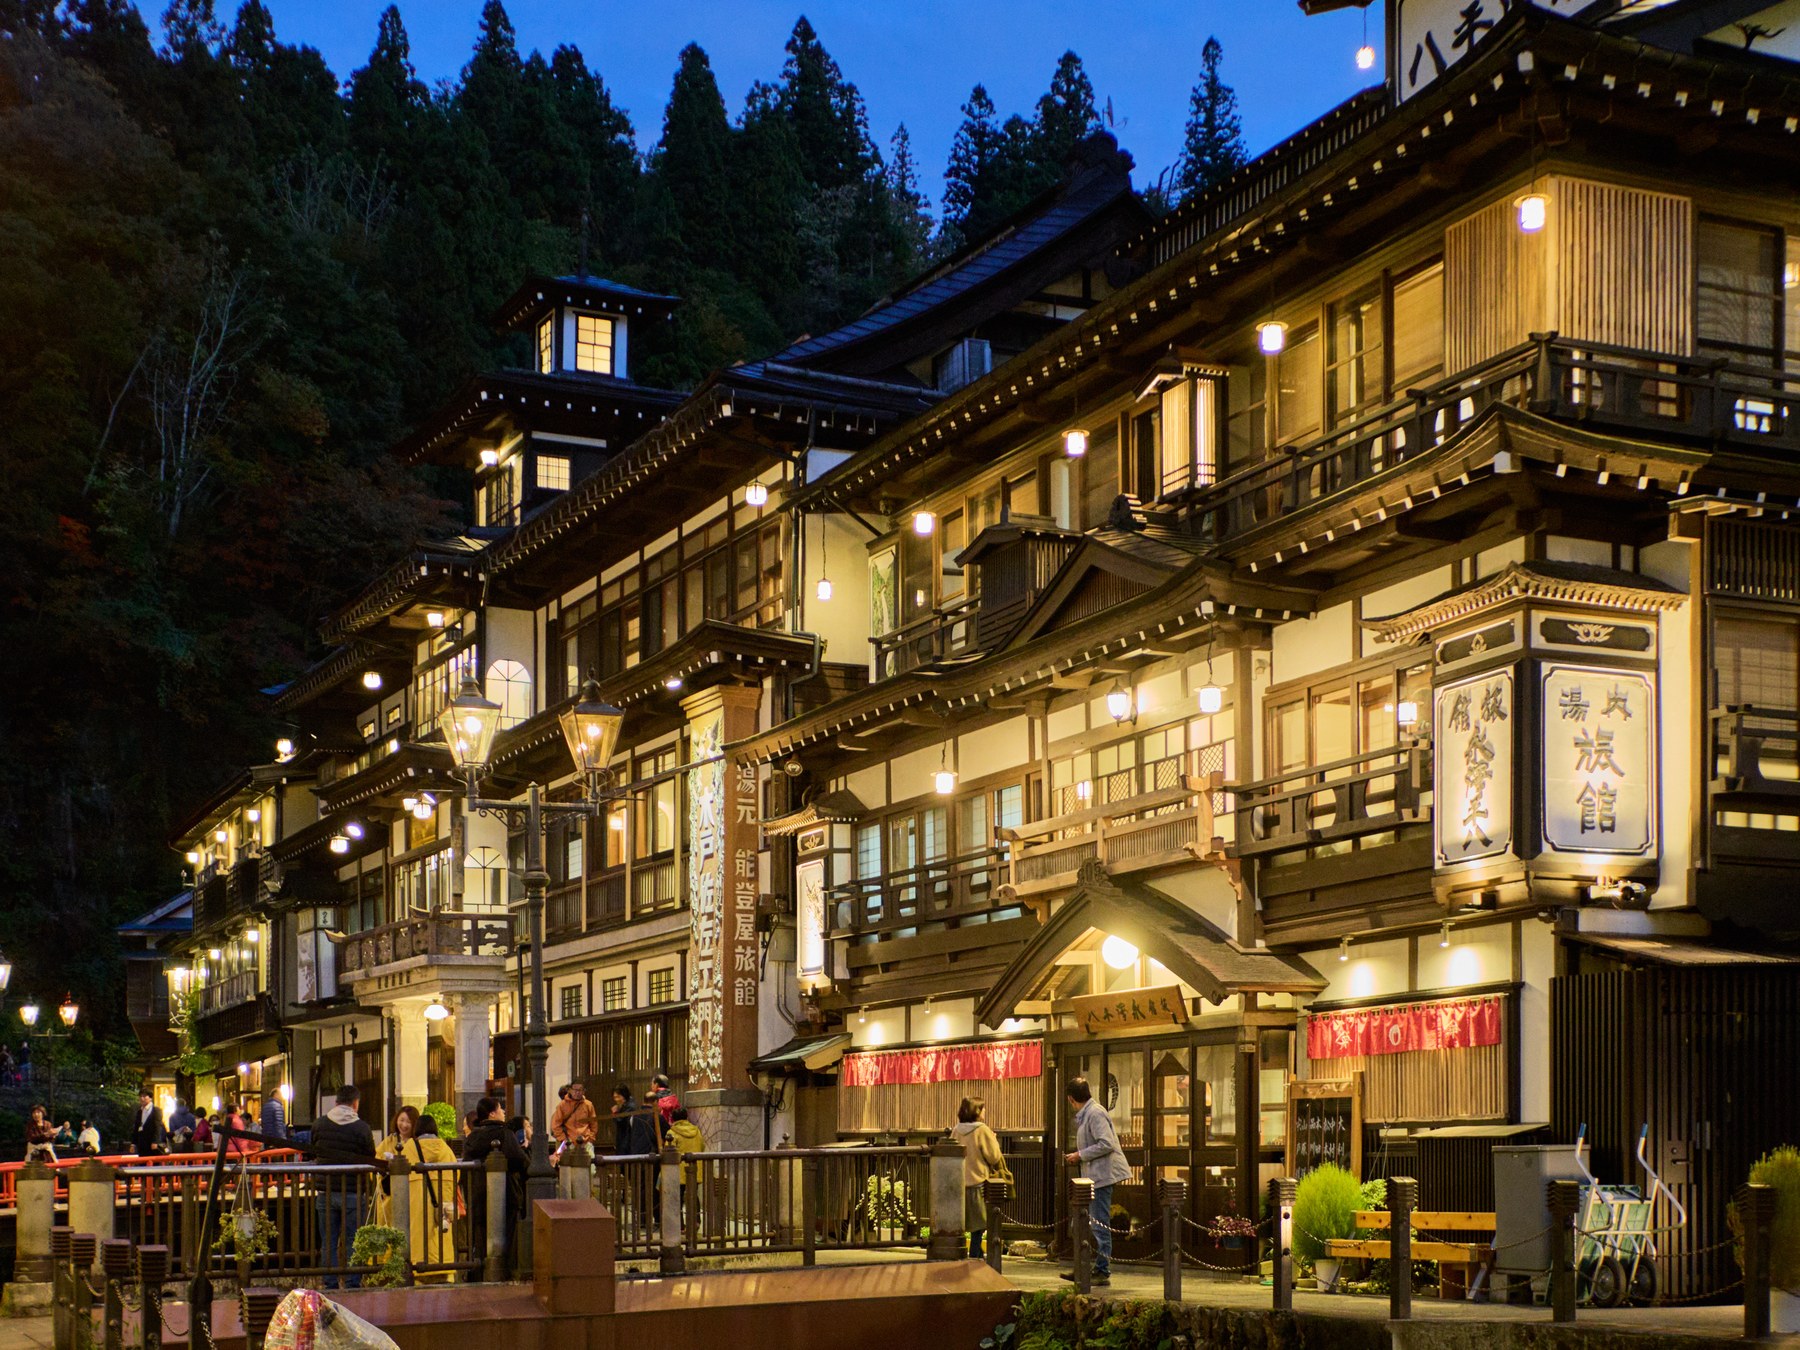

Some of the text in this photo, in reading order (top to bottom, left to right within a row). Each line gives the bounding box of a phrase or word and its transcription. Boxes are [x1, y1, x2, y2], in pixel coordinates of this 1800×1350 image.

[1573, 726, 1625, 834] 旅館
[734, 765, 757, 1006] 湯元 能登屋旅館
